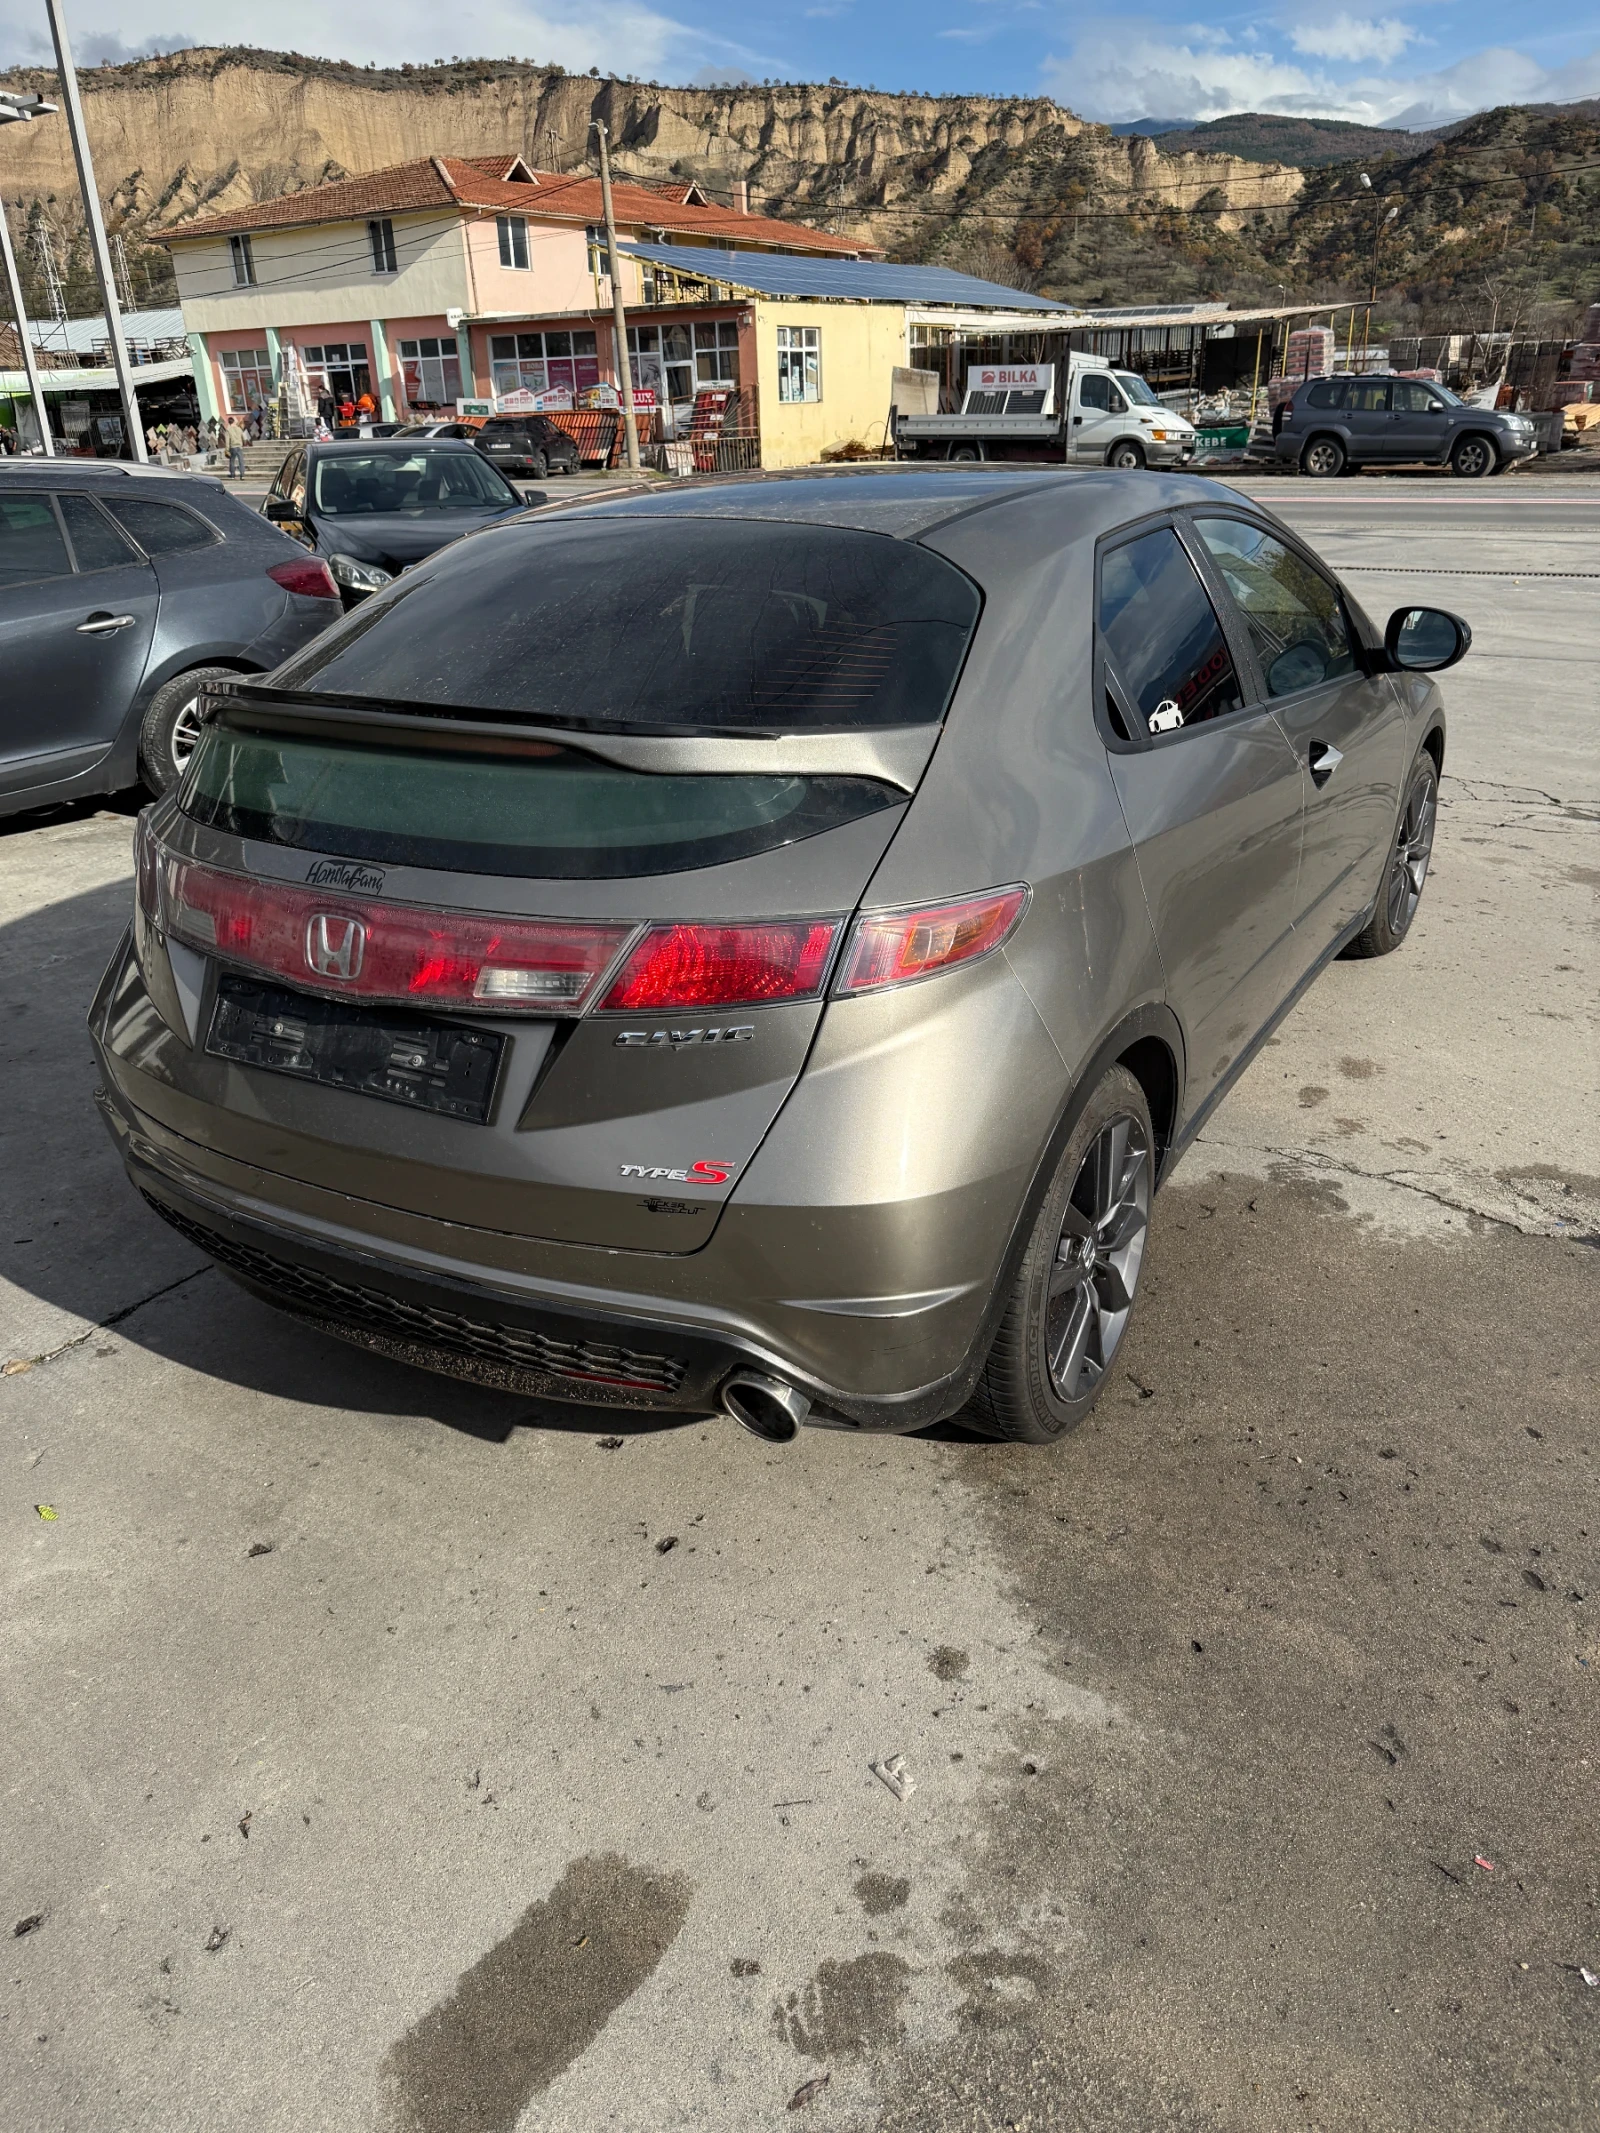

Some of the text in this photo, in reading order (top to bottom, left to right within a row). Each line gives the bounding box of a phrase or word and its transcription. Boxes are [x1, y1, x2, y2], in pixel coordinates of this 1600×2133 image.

[999, 370, 1037, 383] BILKA
[620, 392, 653, 403] LUX
[1196, 437, 1227, 447] KEBE
[614, 1025, 755, 1051] CIVIC
[620, 1160, 736, 1184] TYPE S
[1029, 1309, 1060, 1432] DIAMONDBACK
